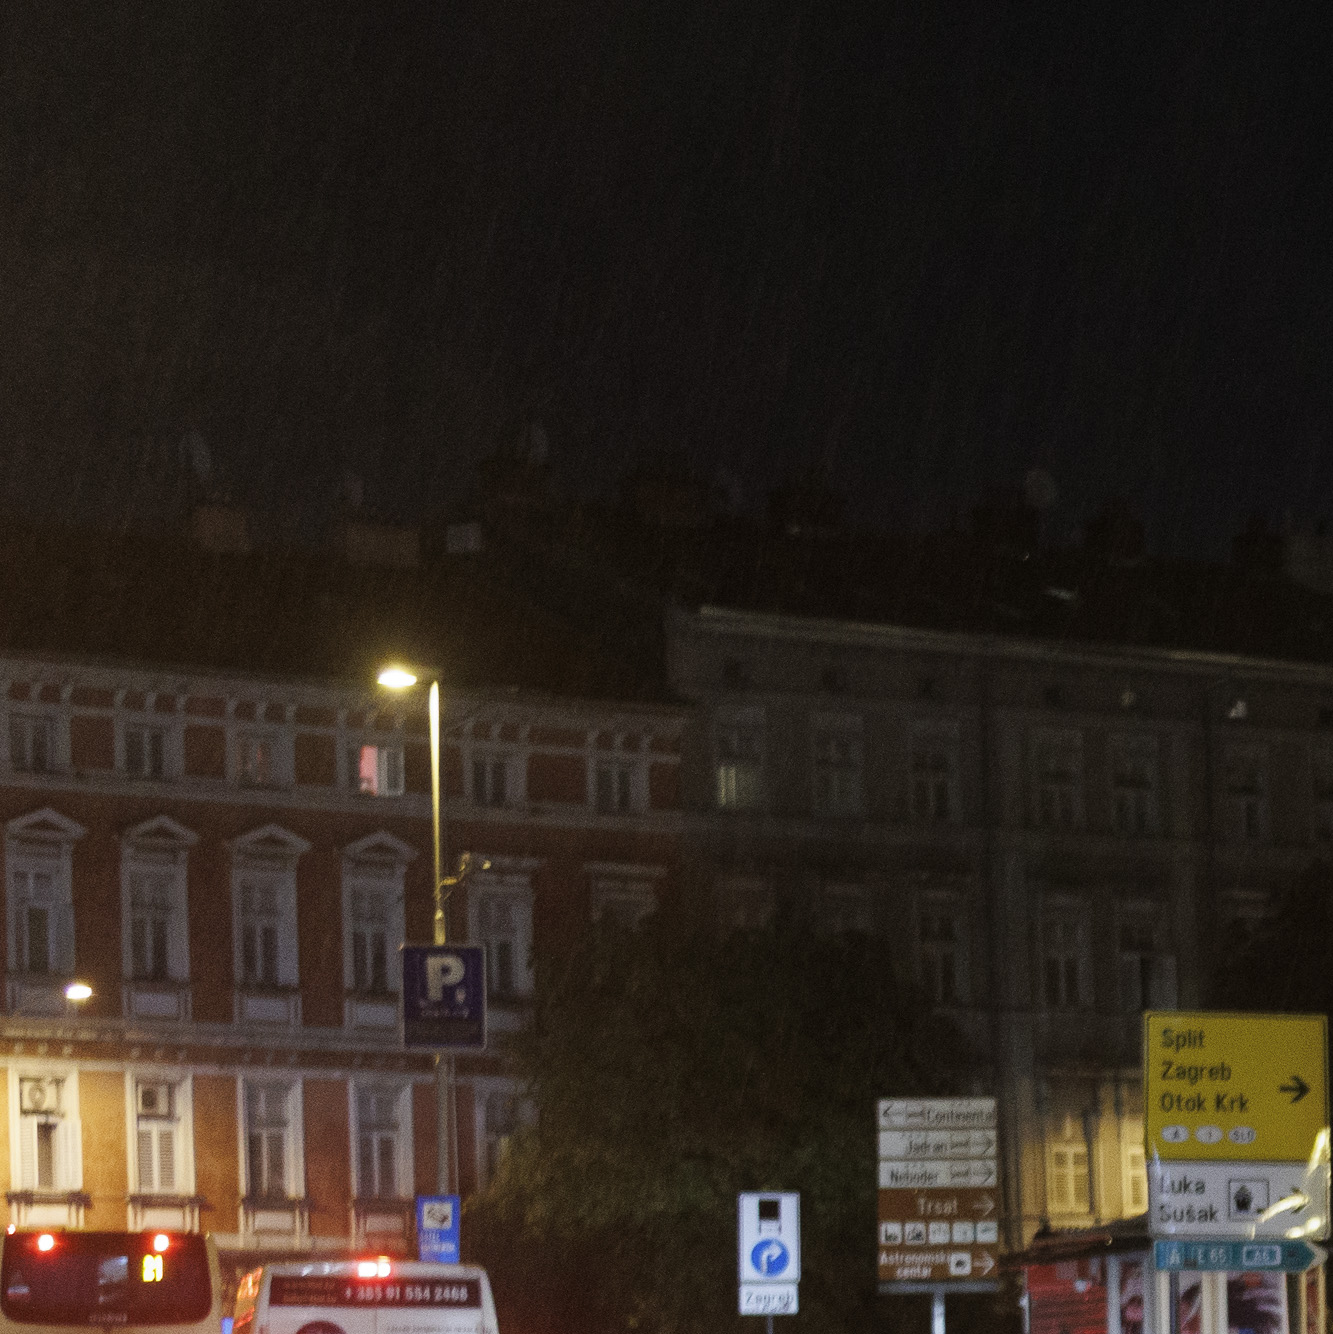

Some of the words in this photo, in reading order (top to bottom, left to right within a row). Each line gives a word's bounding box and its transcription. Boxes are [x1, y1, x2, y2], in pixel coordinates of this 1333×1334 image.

[426, 954, 465, 1001] P
[1160, 1028, 1205, 1052] Split
[1160, 1061, 1231, 1085] Zagreb
[1160, 1093, 1206, 1112] Otok
[1215, 1093, 1249, 1113] Krk
[1160, 1175, 1205, 1194] Luka
[917, 1199, 958, 1216] Trsat
[1160, 1204, 1218, 1222] Sušak
